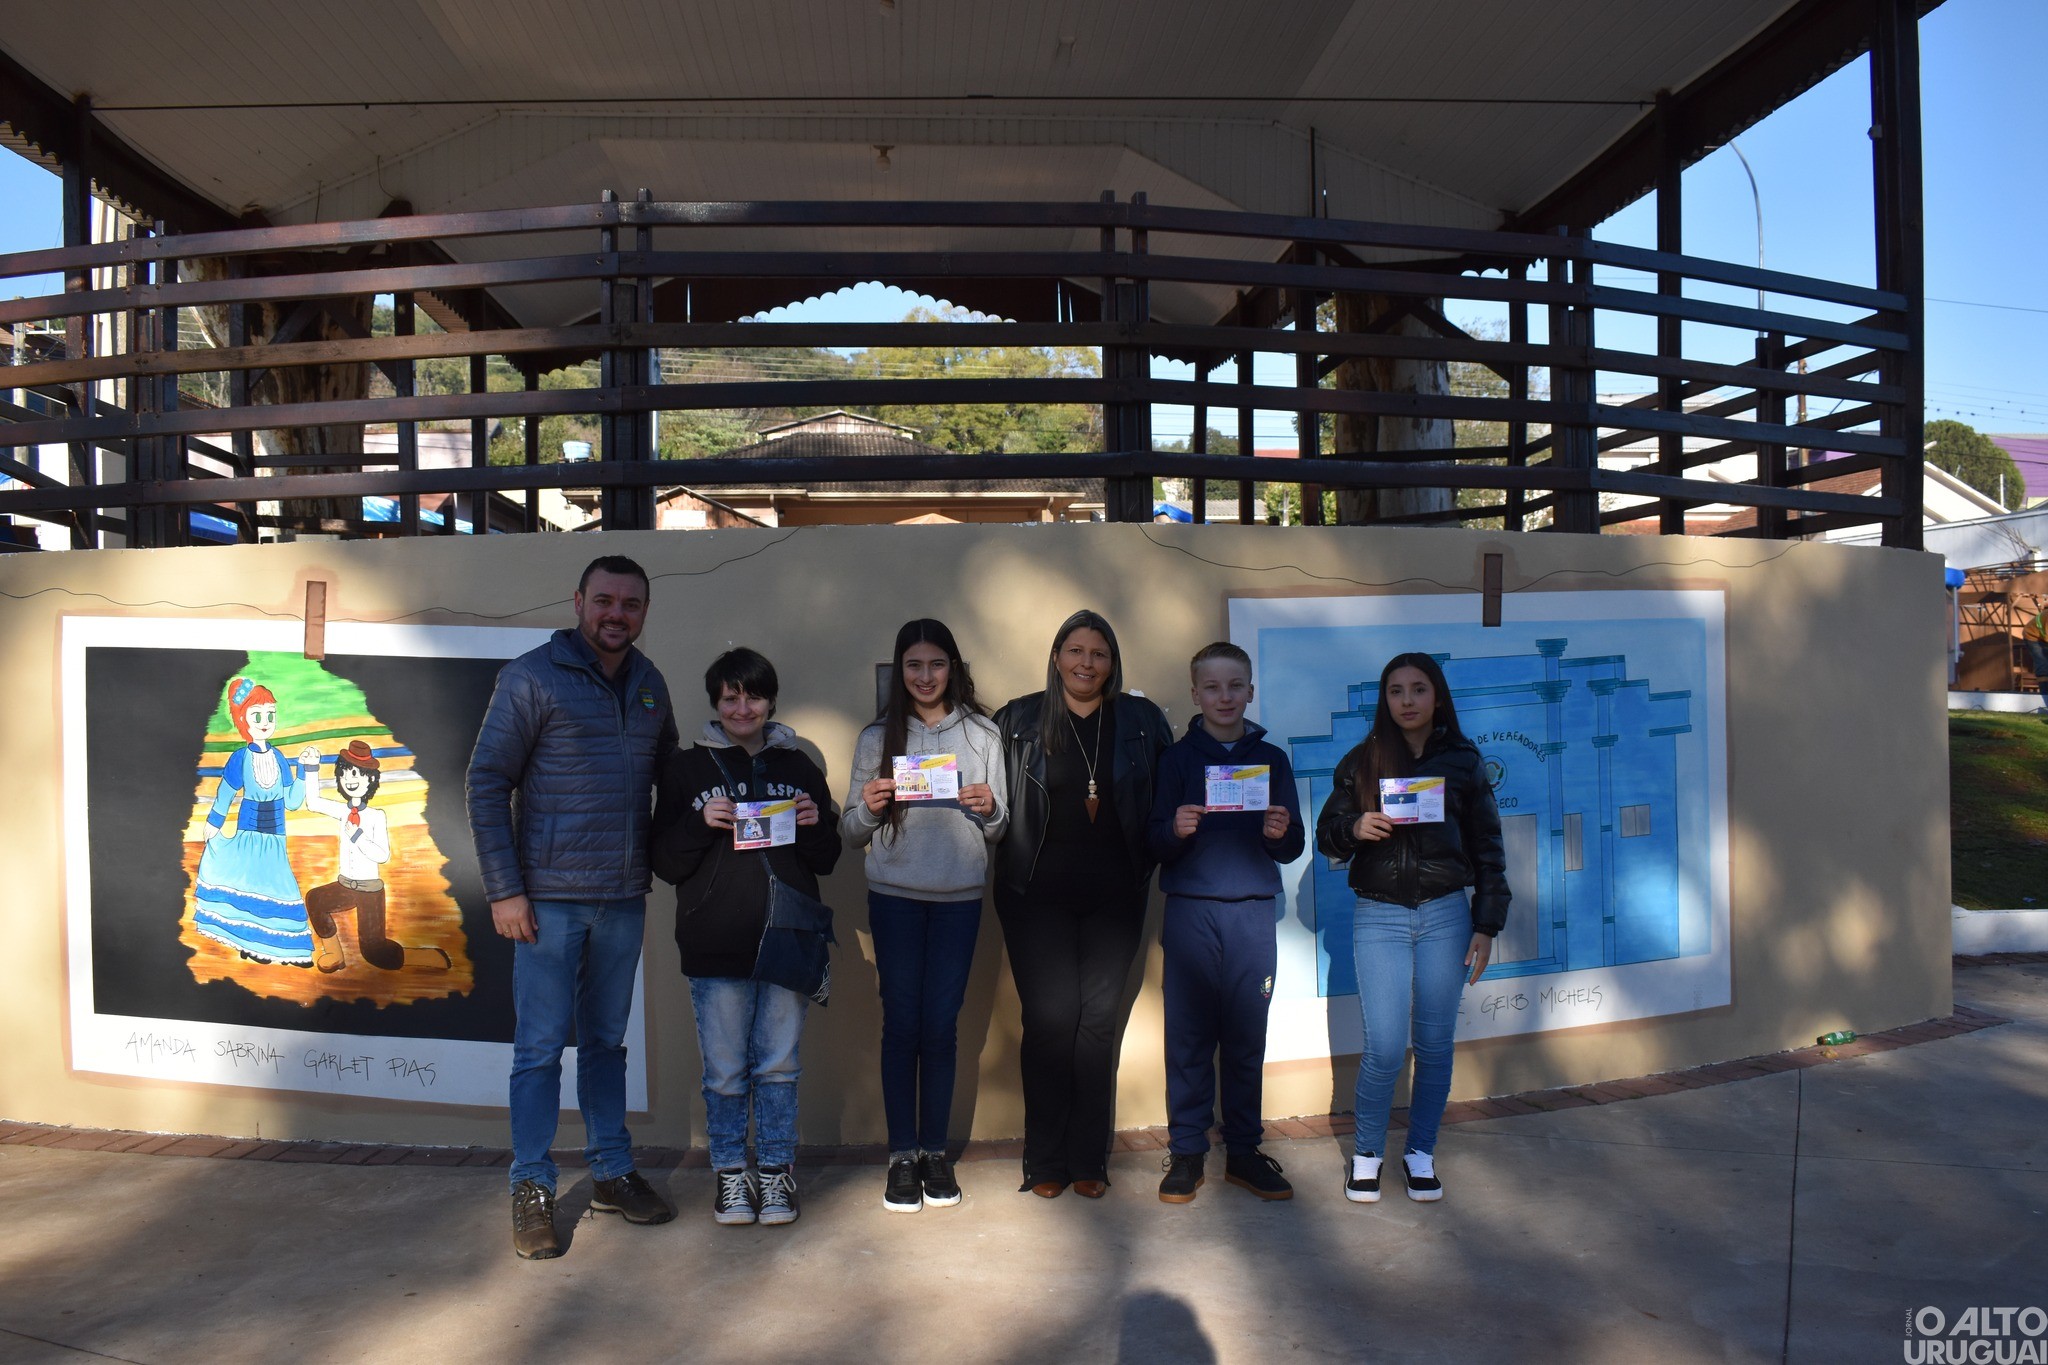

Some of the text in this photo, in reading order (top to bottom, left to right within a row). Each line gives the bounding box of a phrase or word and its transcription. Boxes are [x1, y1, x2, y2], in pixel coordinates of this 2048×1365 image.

[1477, 731, 1547, 763] DE VEREADORES
[1540, 985, 1603, 1013] MICHELS
[125, 1032, 436, 1087] AMANDA SABRINA GARLET PIAS
